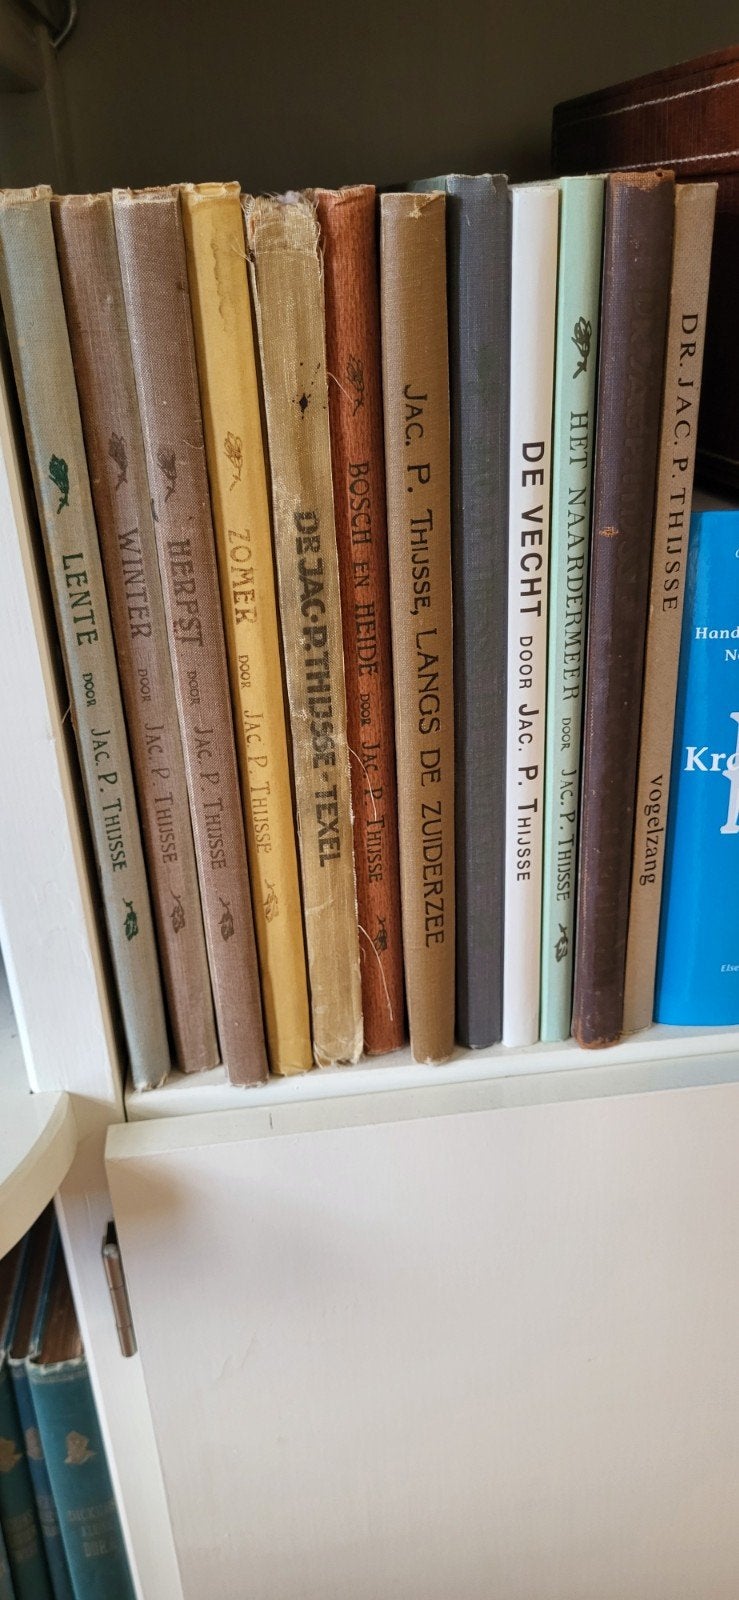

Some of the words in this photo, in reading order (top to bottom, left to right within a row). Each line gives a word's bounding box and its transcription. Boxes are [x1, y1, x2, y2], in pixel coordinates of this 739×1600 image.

[679, 313, 698, 367] DR.
[402, 384, 428, 446] JAC.
[569, 410, 589, 470] HET
[673, 378, 694, 445] JAC.
[406, 462, 431, 493] P.
[521, 441, 545, 487] DE
[671, 456, 689, 479] P.
[349, 462, 373, 545] BOSCH
[228, 528, 257, 625] ZOMER
[352, 562, 370, 589] EN
[409, 508, 434, 616] THIJSSE,
[519, 504, 544, 617] VECHT
[662, 487, 686, 612] THIJSSE
[62, 552, 98, 646] LENTE
[562, 487, 587, 701] NAARDERMEER
[237, 654, 251, 689] DOOR
[355, 602, 378, 677] HEIDE
[518, 635, 533, 689] DOOR
[82, 672, 97, 707] DOOR
[118, 528, 152, 640] WINTER
[138, 669, 151, 702] DOOR
[154, 791, 178, 864] THIJSSE
[360, 693, 372, 727] DOOR
[416, 627, 441, 735] LANGS
[90, 728, 111, 766] JAC.
[518, 703, 540, 751] JAC.
[560, 717, 572, 752] DOOR
[98, 771, 118, 792] P.
[186, 670, 201, 705] DOOR
[203, 797, 227, 870] THIJSSE
[361, 741, 381, 778] JAC.
[420, 747, 441, 787] DE
[518, 765, 539, 786] P.
[559, 769, 577, 806] JAC.
[102, 797, 128, 872] THIJSSE
[250, 781, 272, 854] THIJSSE
[315, 784, 341, 867] TEXEL
[366, 815, 385, 884] THIJSSE
[516, 798, 538, 882] THIJSSE
[559, 810, 576, 830] P.
[639, 774, 664, 886] vogelzang
[421, 800, 445, 948] ZUIDERZEE
[556, 833, 575, 902] THIJSSE
